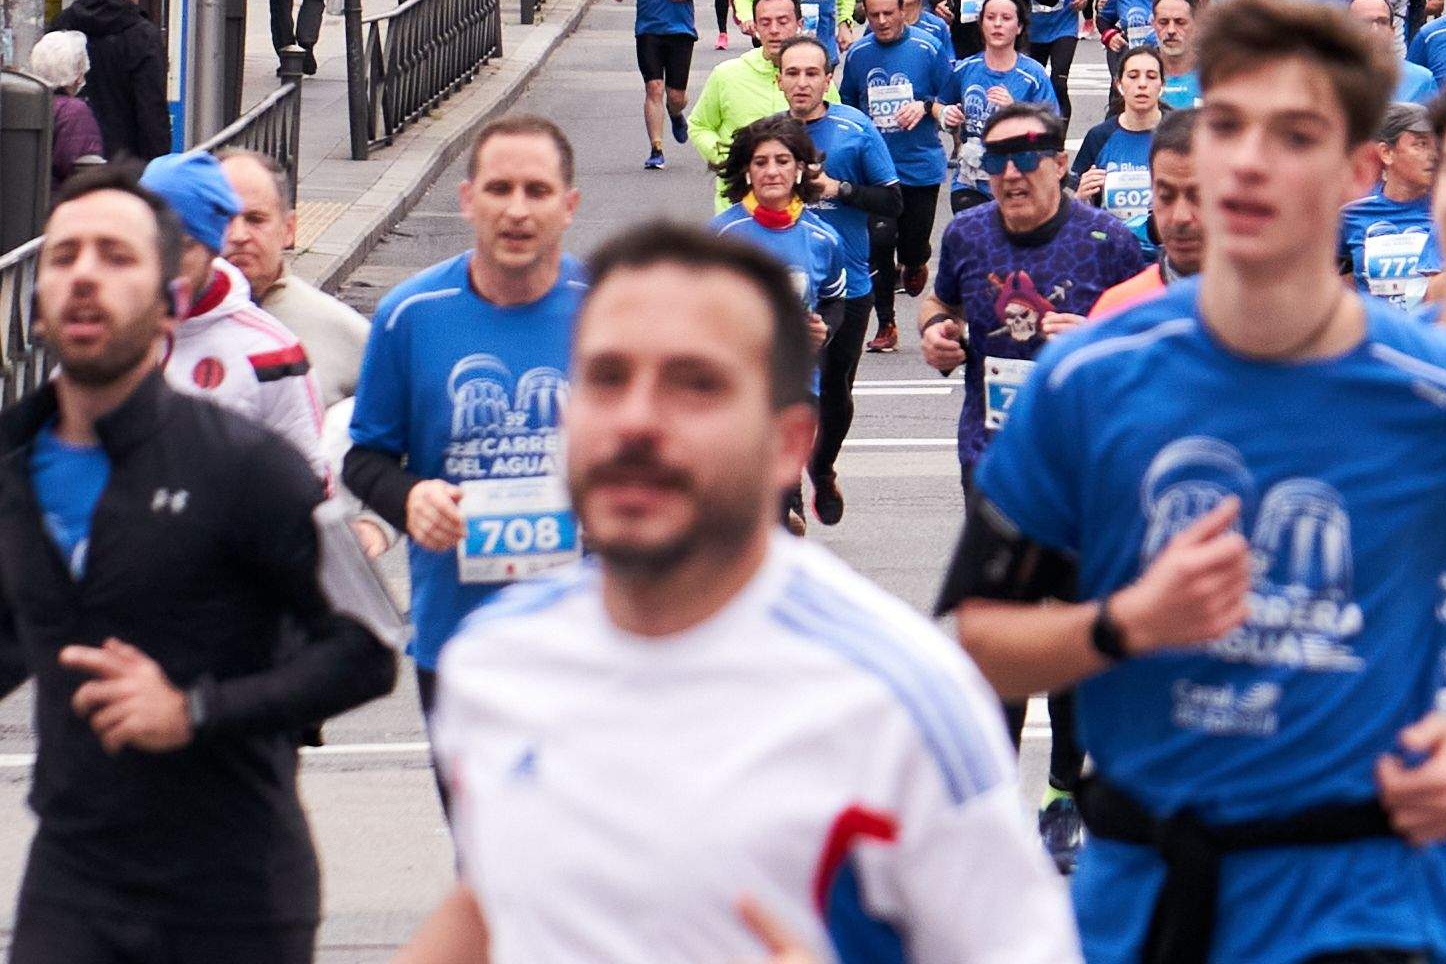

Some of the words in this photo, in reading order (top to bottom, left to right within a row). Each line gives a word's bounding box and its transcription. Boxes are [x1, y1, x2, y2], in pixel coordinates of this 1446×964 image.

[479, 436, 557, 457] CARRE
[489, 453, 554, 476] AGUA
[478, 516, 561, 553] 708
